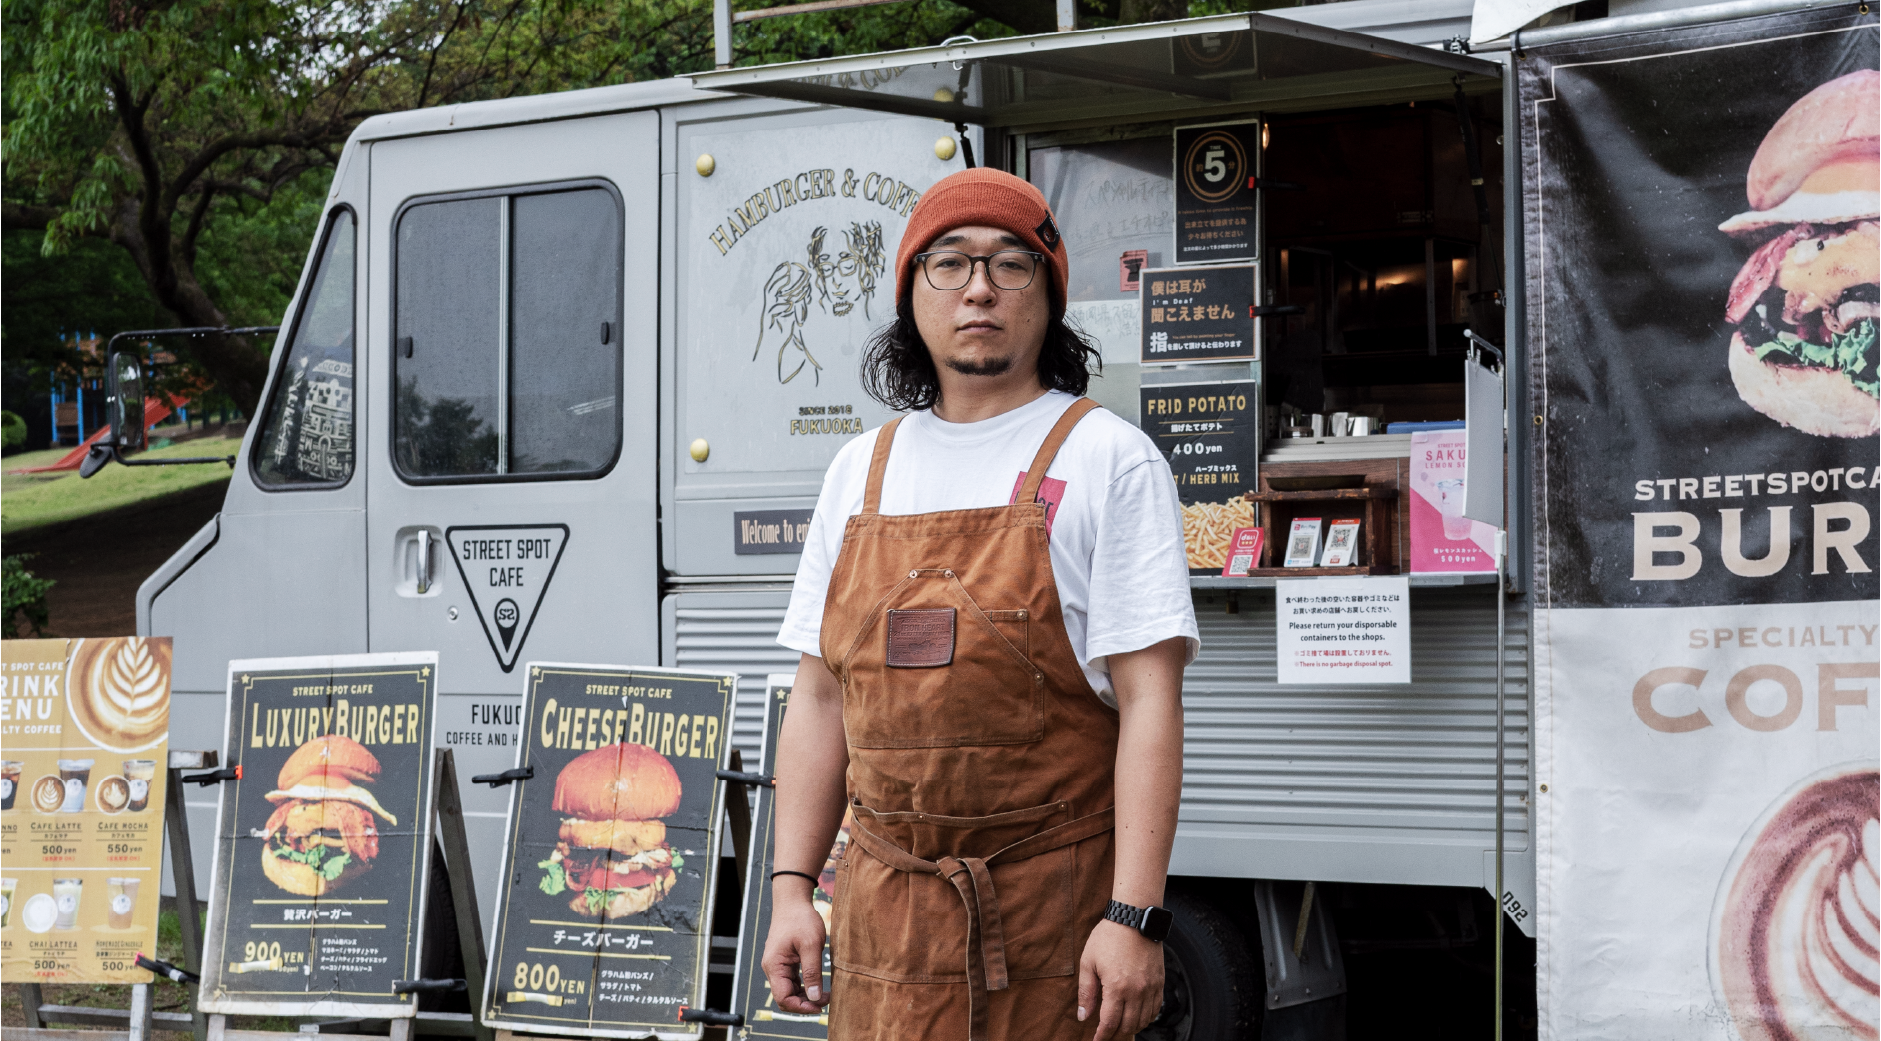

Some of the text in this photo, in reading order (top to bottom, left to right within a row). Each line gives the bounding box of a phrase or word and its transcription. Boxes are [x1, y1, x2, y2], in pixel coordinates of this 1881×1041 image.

[1204, 150, 1226, 182] 5
[709, 168, 836, 256] HAMBURGER
[841, 168, 860, 199] &
[1188, 230, 1244, 241] 少々お待ちください
[1151, 278, 1207, 296] 僕は耳が
[1151, 304, 1235, 323] 聞こえません
[1148, 395, 1246, 415] FRID POTATO
[790, 417, 863, 436] FUKUOKA
[1171, 422, 1223, 433] 揚げたてポテト
[1173, 442, 1223, 455] 400 yen
[1425, 449, 1466, 461] SAKU
[1195, 464, 1237, 473] ハーブミックス
[1190, 473, 1217, 485] HERB
[1221, 472, 1239, 483] MIX
[741, 519, 780, 545] Welcome
[783, 519, 794, 543] to
[1629, 501, 1873, 581] BUR
[463, 539, 551, 560] STREET SPOT
[490, 567, 524, 587] CAFE
[1289, 621, 1312, 629] Please
[1337, 622, 1354, 631] your
[1355, 620, 1398, 630] disporsable
[1300, 632, 1386, 642] containers to the shops.
[1688, 624, 1880, 649] SPECIALTY
[11, 662, 35, 671] SPOT
[38, 661, 64, 671] CAFE
[1330, 661, 1353, 669] garbage
[1354, 660, 1378, 668] disposal
[292, 684, 373, 697] STREET SPOT CAFE
[586, 684, 673, 699] STREET SPOT CAFE
[1632, 661, 1880, 734] COF
[24, 724, 62, 734] COFFEE
[446, 731, 483, 745] COFFEE
[487, 732, 508, 746] AND
[31, 822, 82, 830] CAFE LATTE
[98, 822, 149, 830] CAFE MOCHA
[43, 845, 63, 854] 500
[107, 844, 128, 853] 550
[284, 908, 352, 921] 贅沢バーガー
[553, 929, 654, 950] チーズバーガー
[245, 941, 304, 963] 900 YEN
[34, 960, 56, 970] 500
[103, 962, 124, 971] 500
[514, 962, 586, 995] 800 YEN
